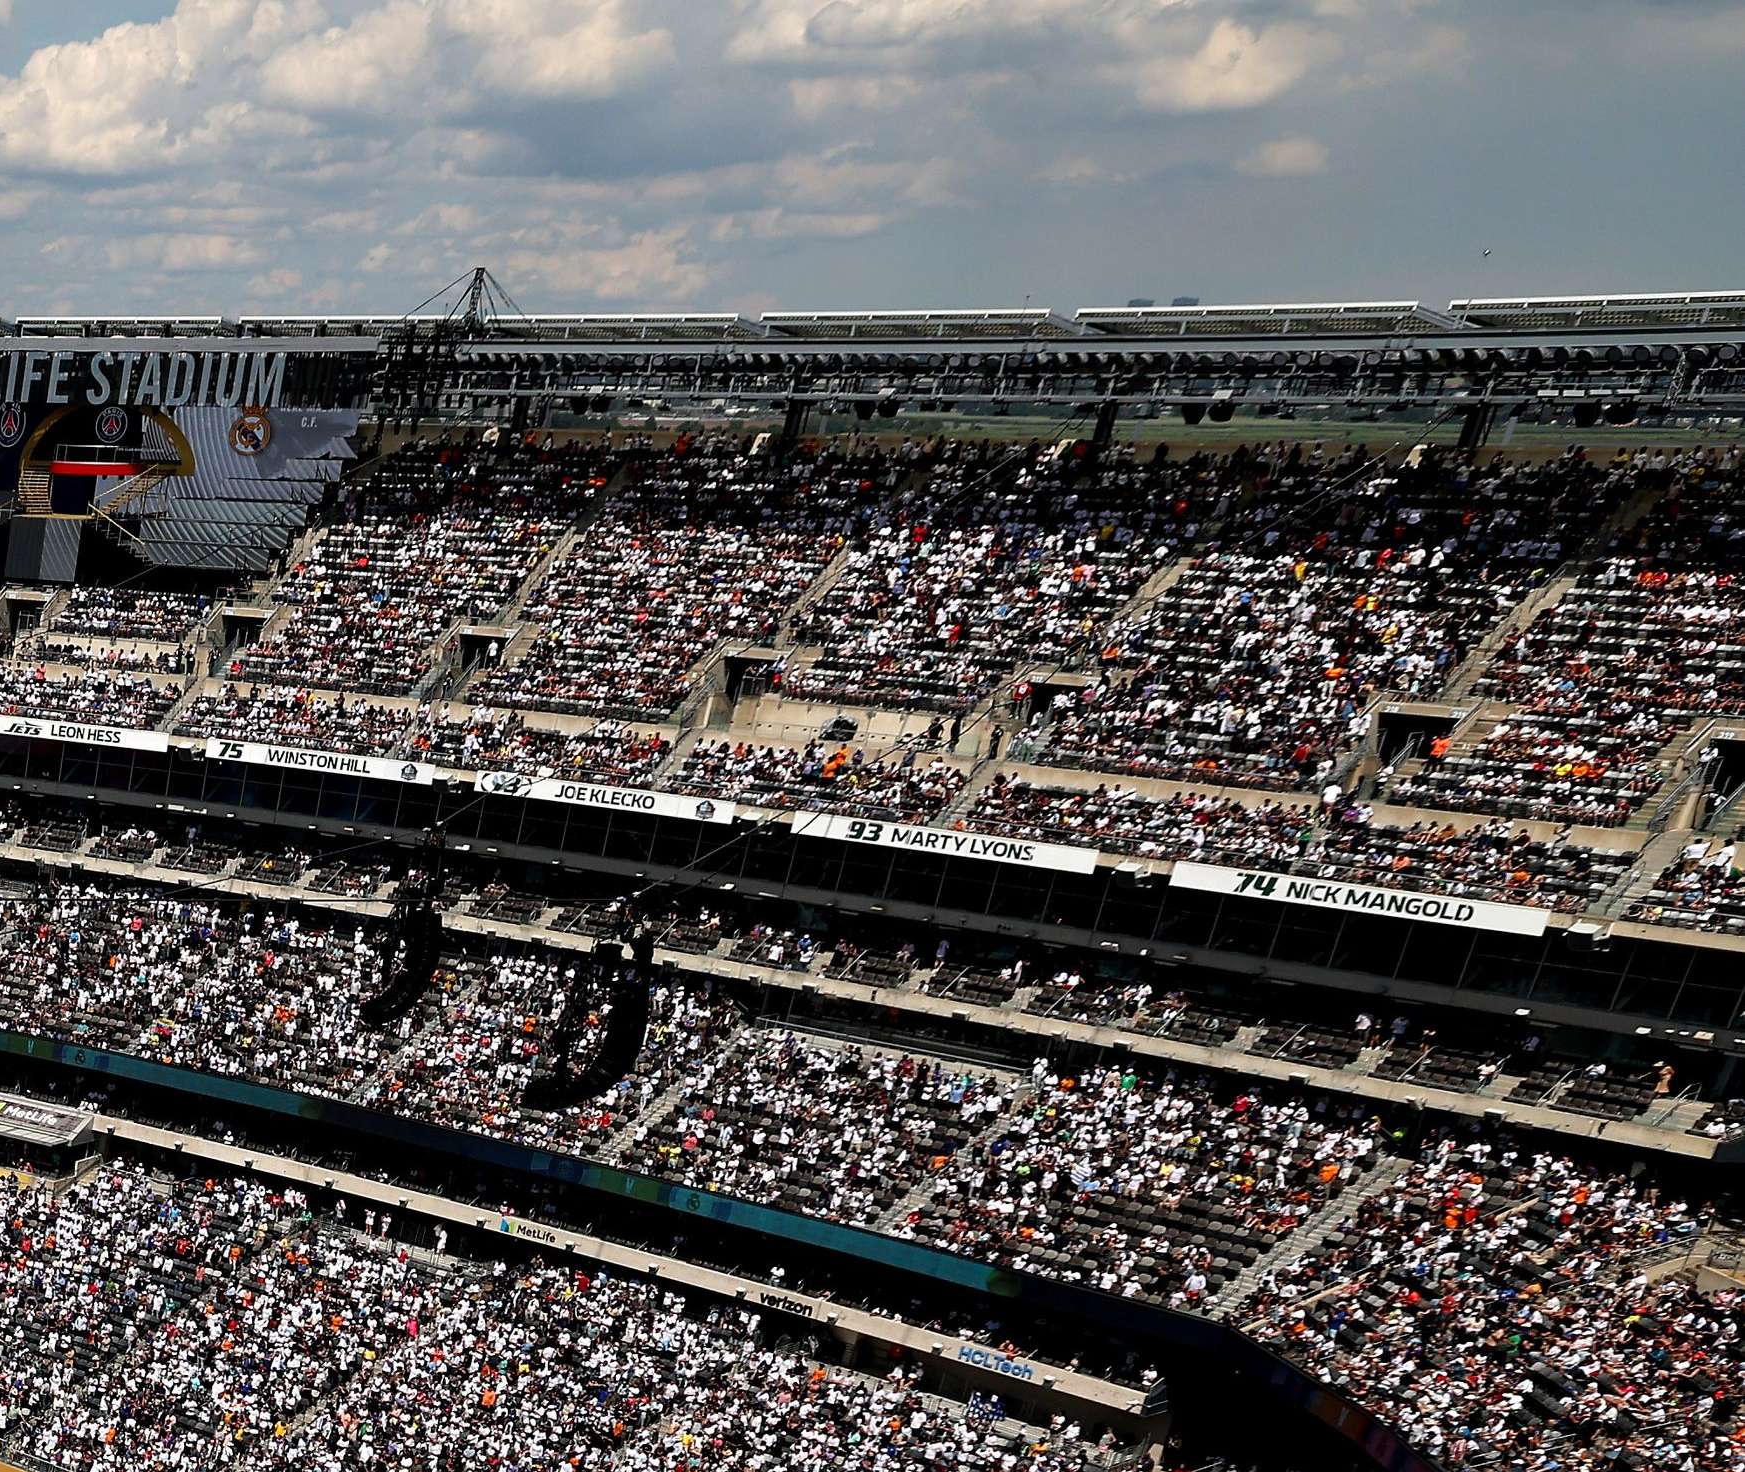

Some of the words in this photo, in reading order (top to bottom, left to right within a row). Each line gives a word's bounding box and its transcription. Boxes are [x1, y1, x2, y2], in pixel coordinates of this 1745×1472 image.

[85, 350, 288, 408] STADIUM
[50, 723, 84, 740] LEON
[86, 726, 121, 744] HESS
[218, 742, 243, 759] 75
[266, 747, 337, 771] WINSTON
[339, 755, 371, 774] HILL
[554, 783, 580, 801] JOE
[582, 785, 656, 810] KLECKO
[849, 821, 883, 841] 93
[891, 827, 967, 852] MARTY
[969, 836, 1034, 861] LYONS
[1233, 872, 1278, 897] 74
[1285, 881, 1342, 904] NICK
[1344, 891, 1475, 922] MANGOLD
[2, 1104, 59, 1125] MetLife
[516, 1224, 556, 1243] MetLife
[759, 1292, 813, 1317] verizon
[957, 1346, 1034, 1380] HCLTech
